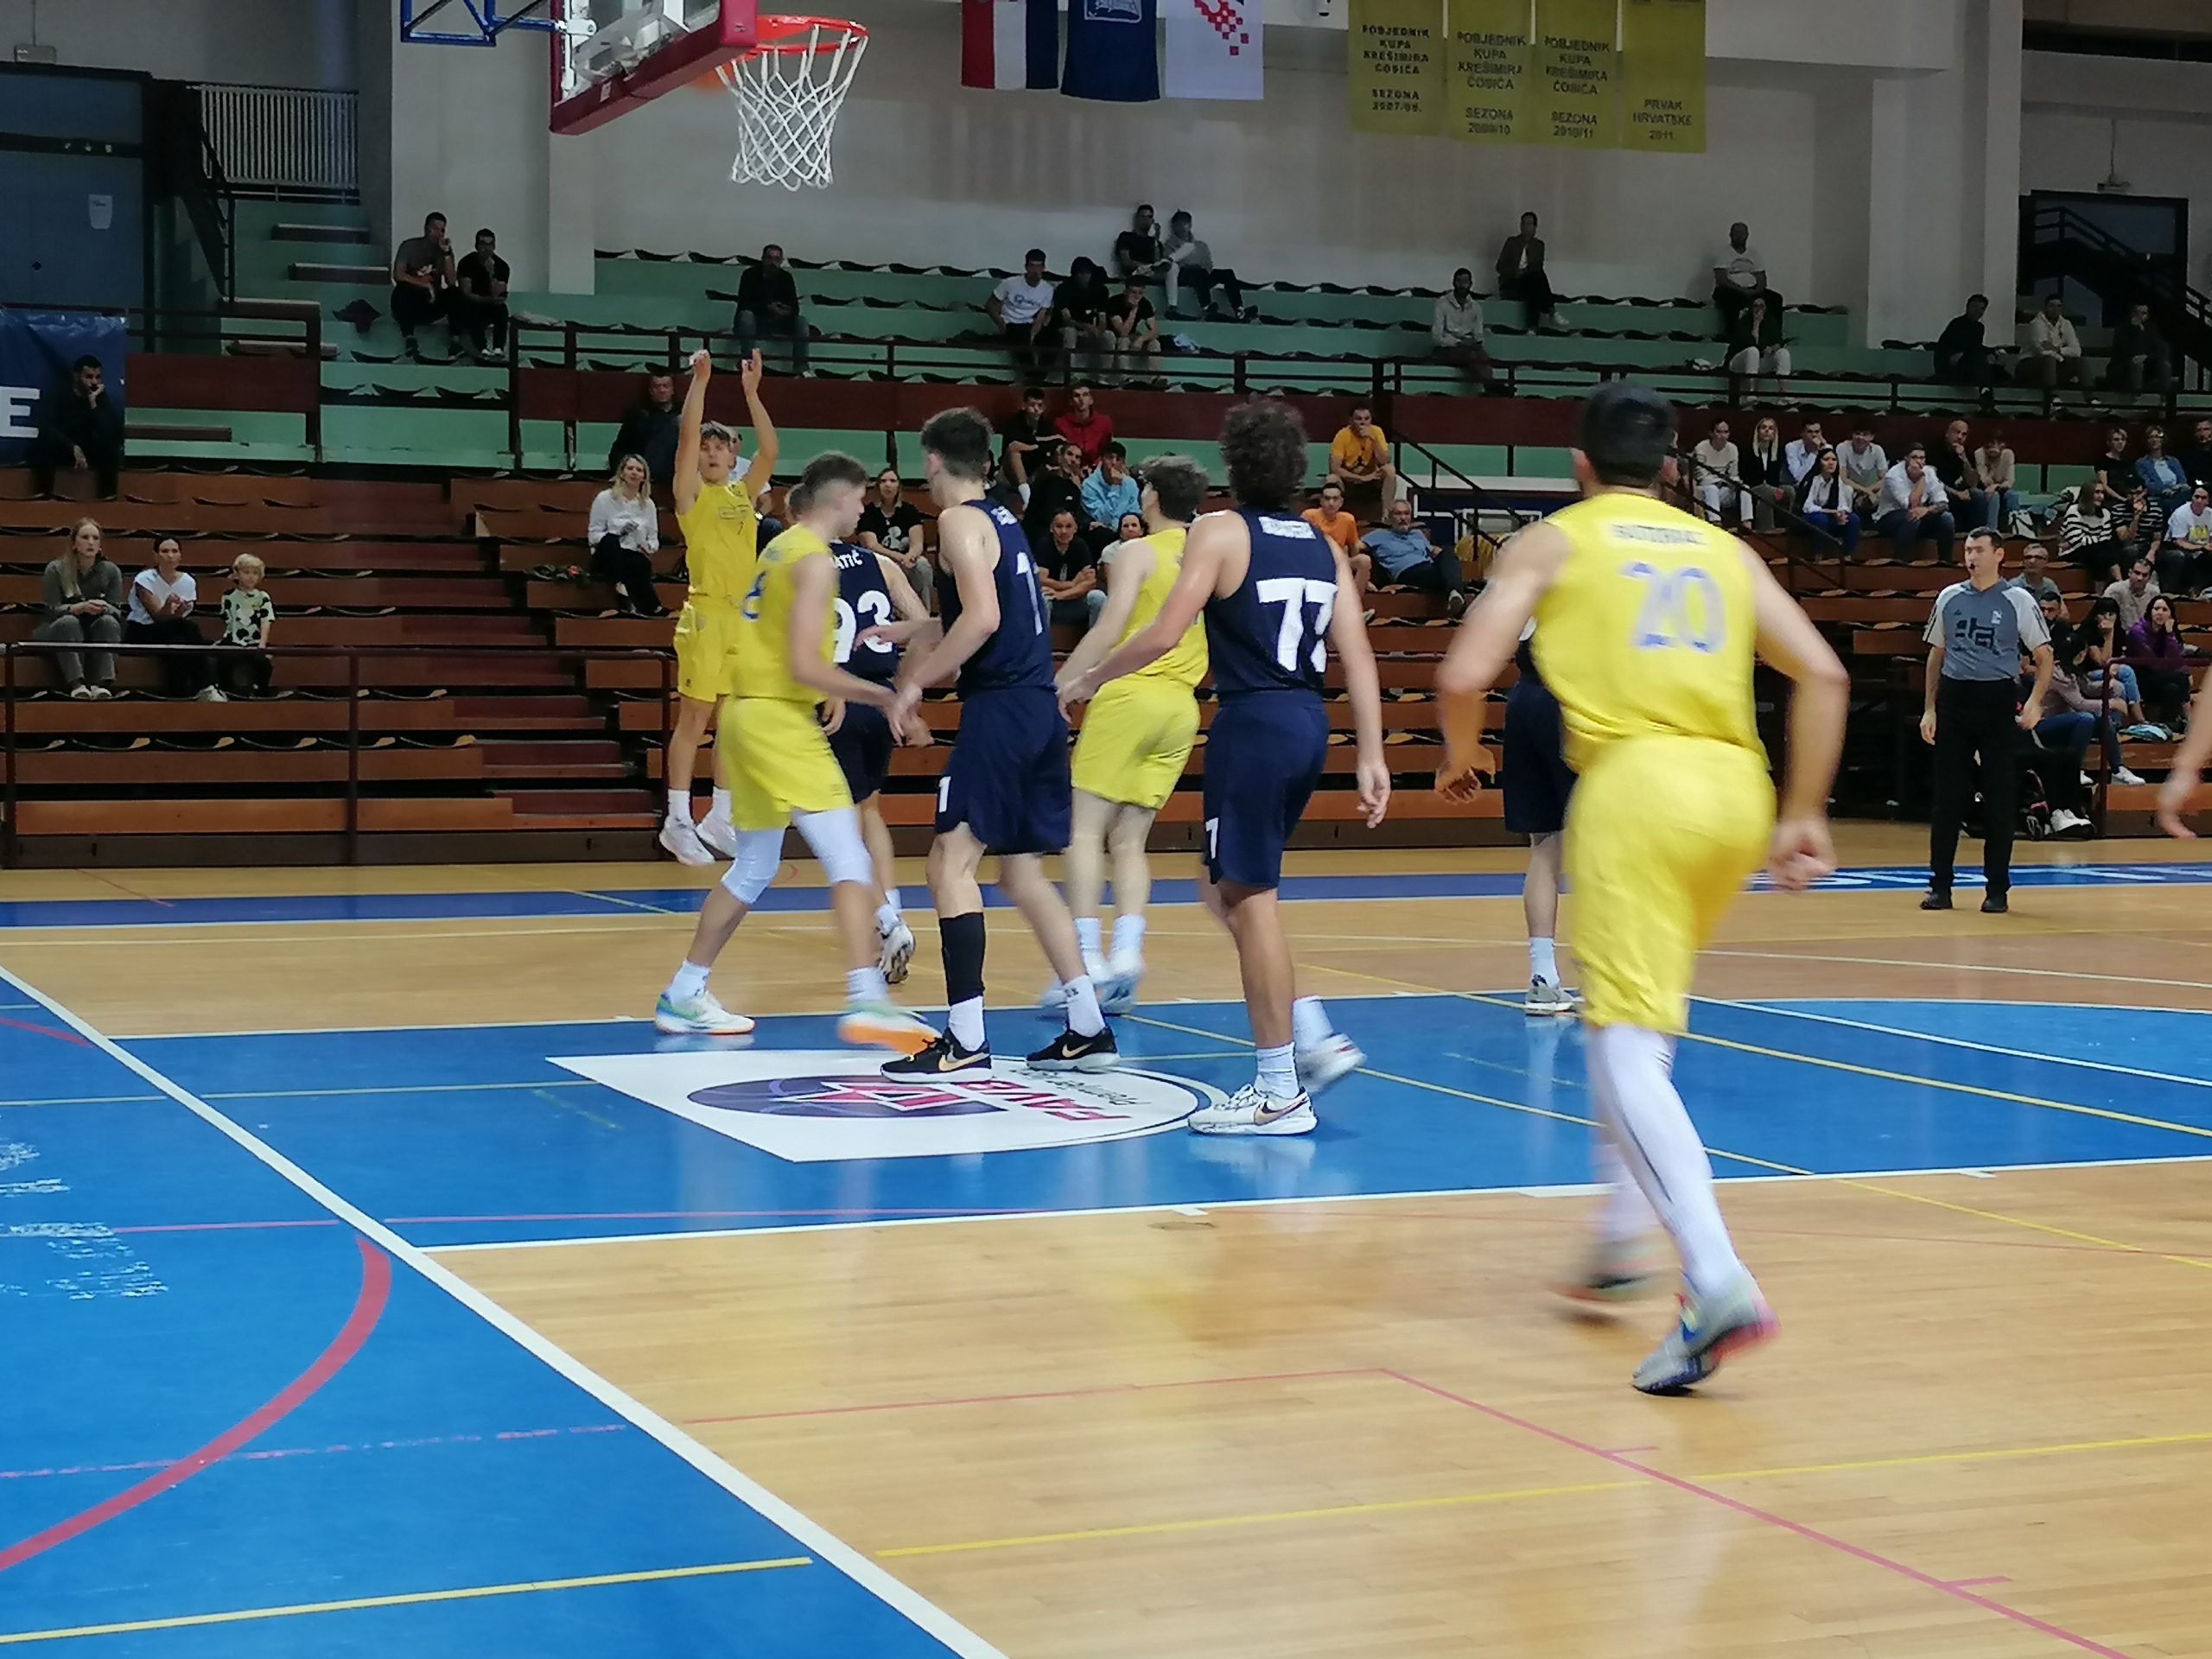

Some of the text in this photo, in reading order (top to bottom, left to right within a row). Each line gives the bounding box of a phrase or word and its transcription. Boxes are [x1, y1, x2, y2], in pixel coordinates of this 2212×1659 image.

[1379, 39, 1411, 49] KUPA
[1457, 32, 1526, 47] POBJEDNIK
[1544, 35, 1611, 53] POBJEDNIK
[1473, 48, 1506, 60] KUPA
[1559, 54, 1592, 66] KUPA
[1371, 89, 1420, 100] SEZONA
[1644, 99, 1682, 111] PRVAK
[1465, 107, 1514, 121] SEZONA
[1551, 111, 1598, 125] SEZONA
[1632, 111, 1693, 126] HRVATSKE
[1619, 560, 1728, 654] 20
[1255, 577, 1338, 672] 77
